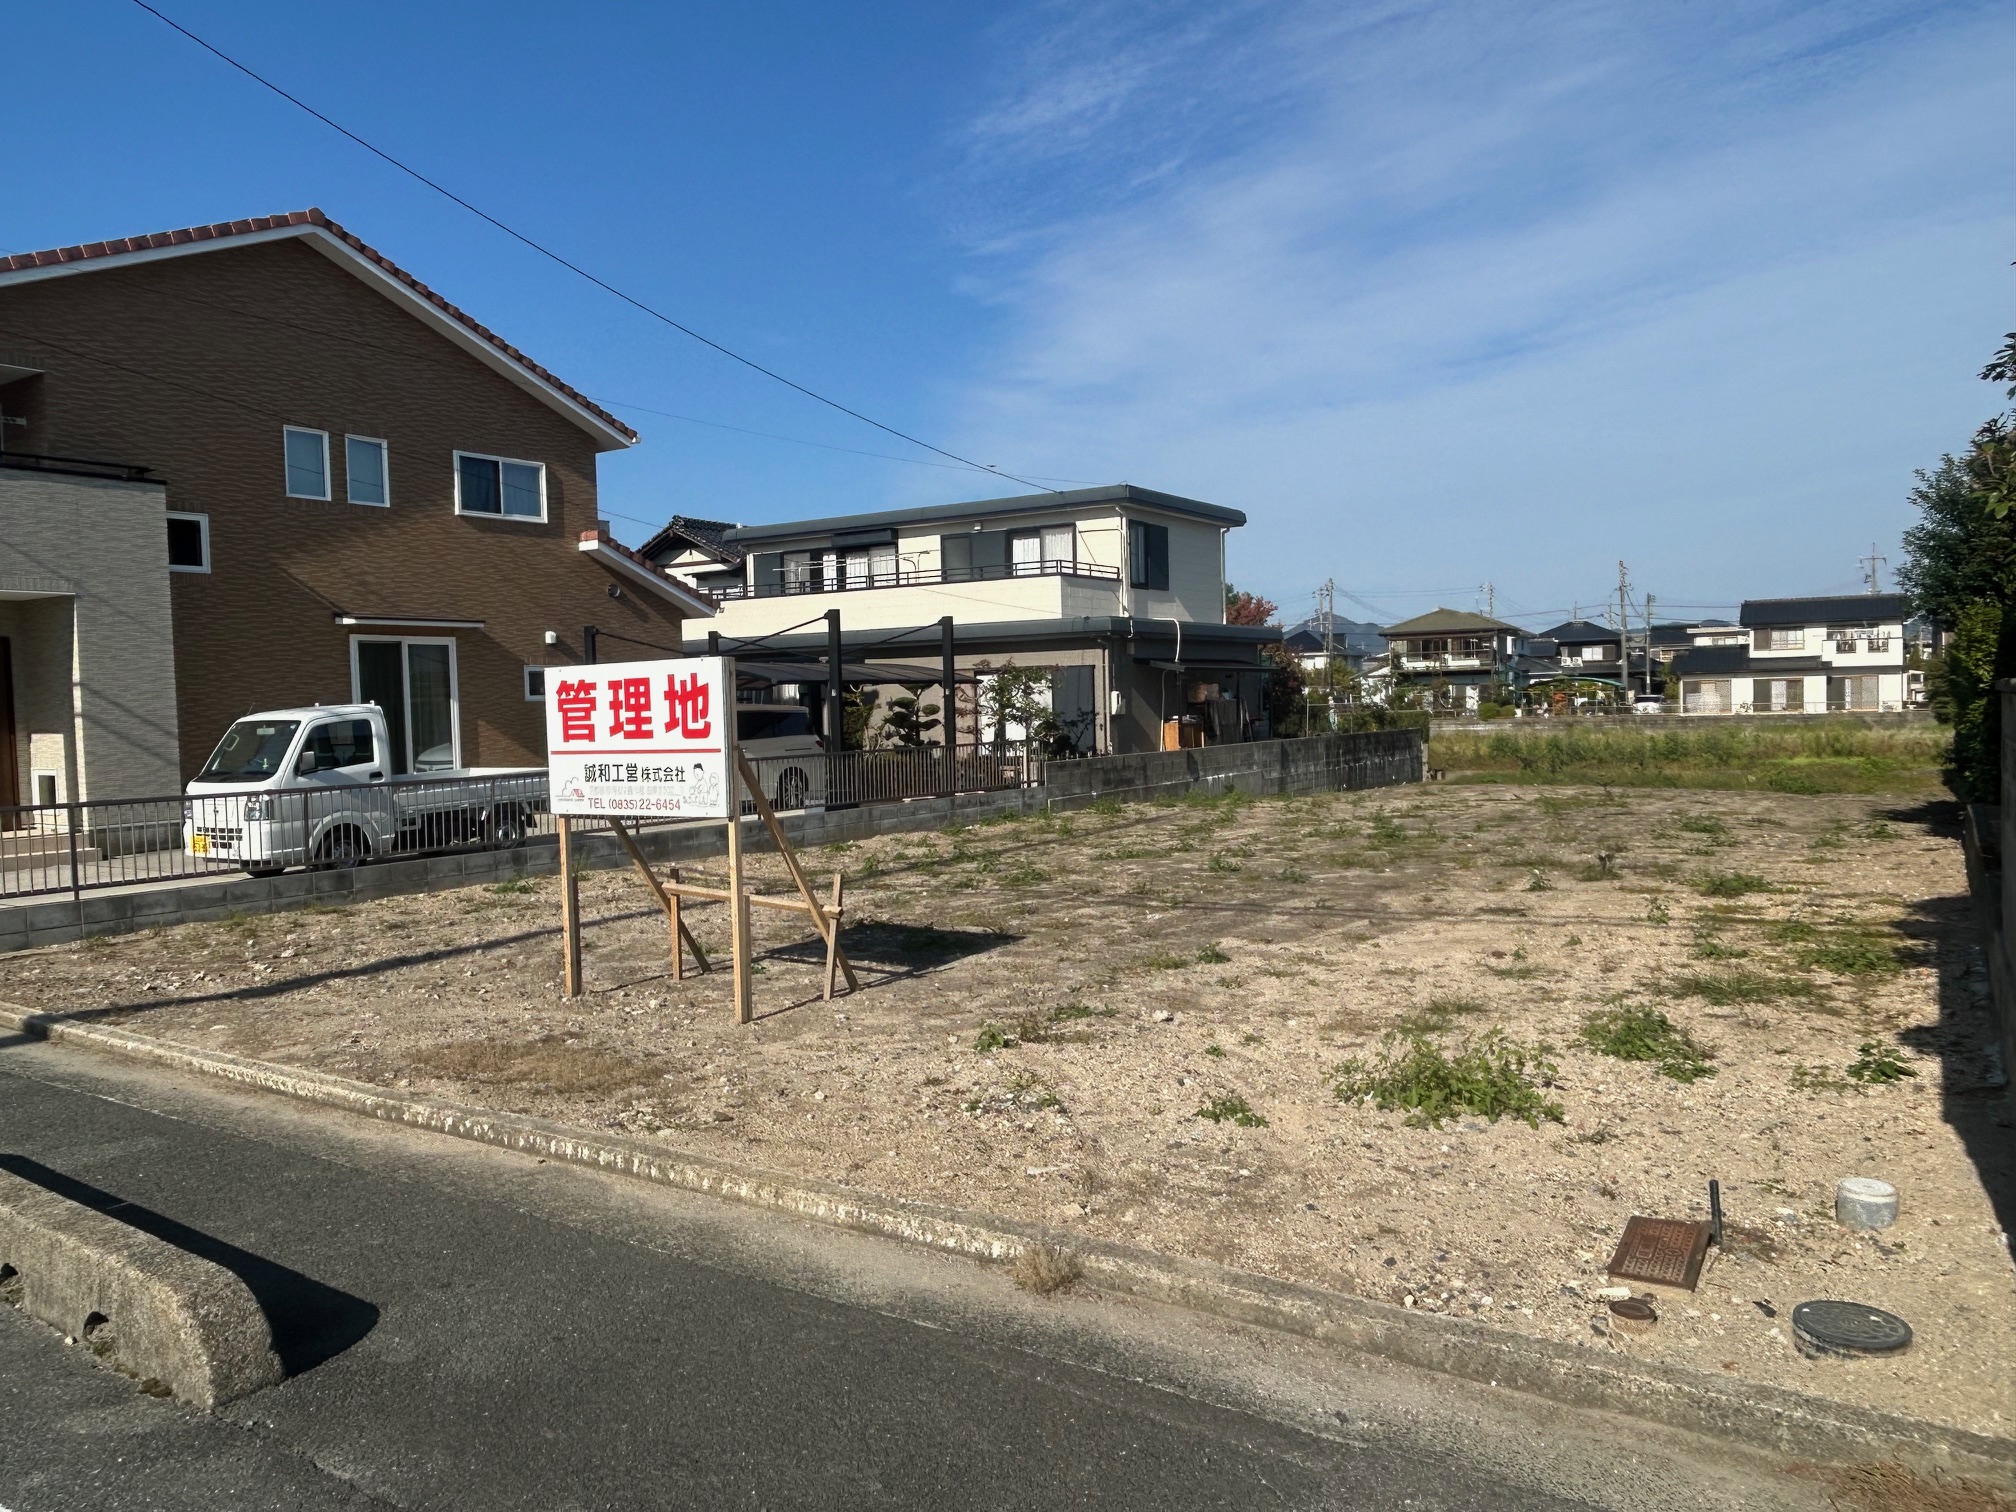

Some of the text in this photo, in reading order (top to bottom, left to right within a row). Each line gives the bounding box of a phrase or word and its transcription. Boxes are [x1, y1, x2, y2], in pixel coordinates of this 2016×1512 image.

[555, 672, 712, 743] 管理地
[584, 762, 686, 783] 誠和工営株式会社
[587, 797, 681, 811] TEL (0835)22-6454
